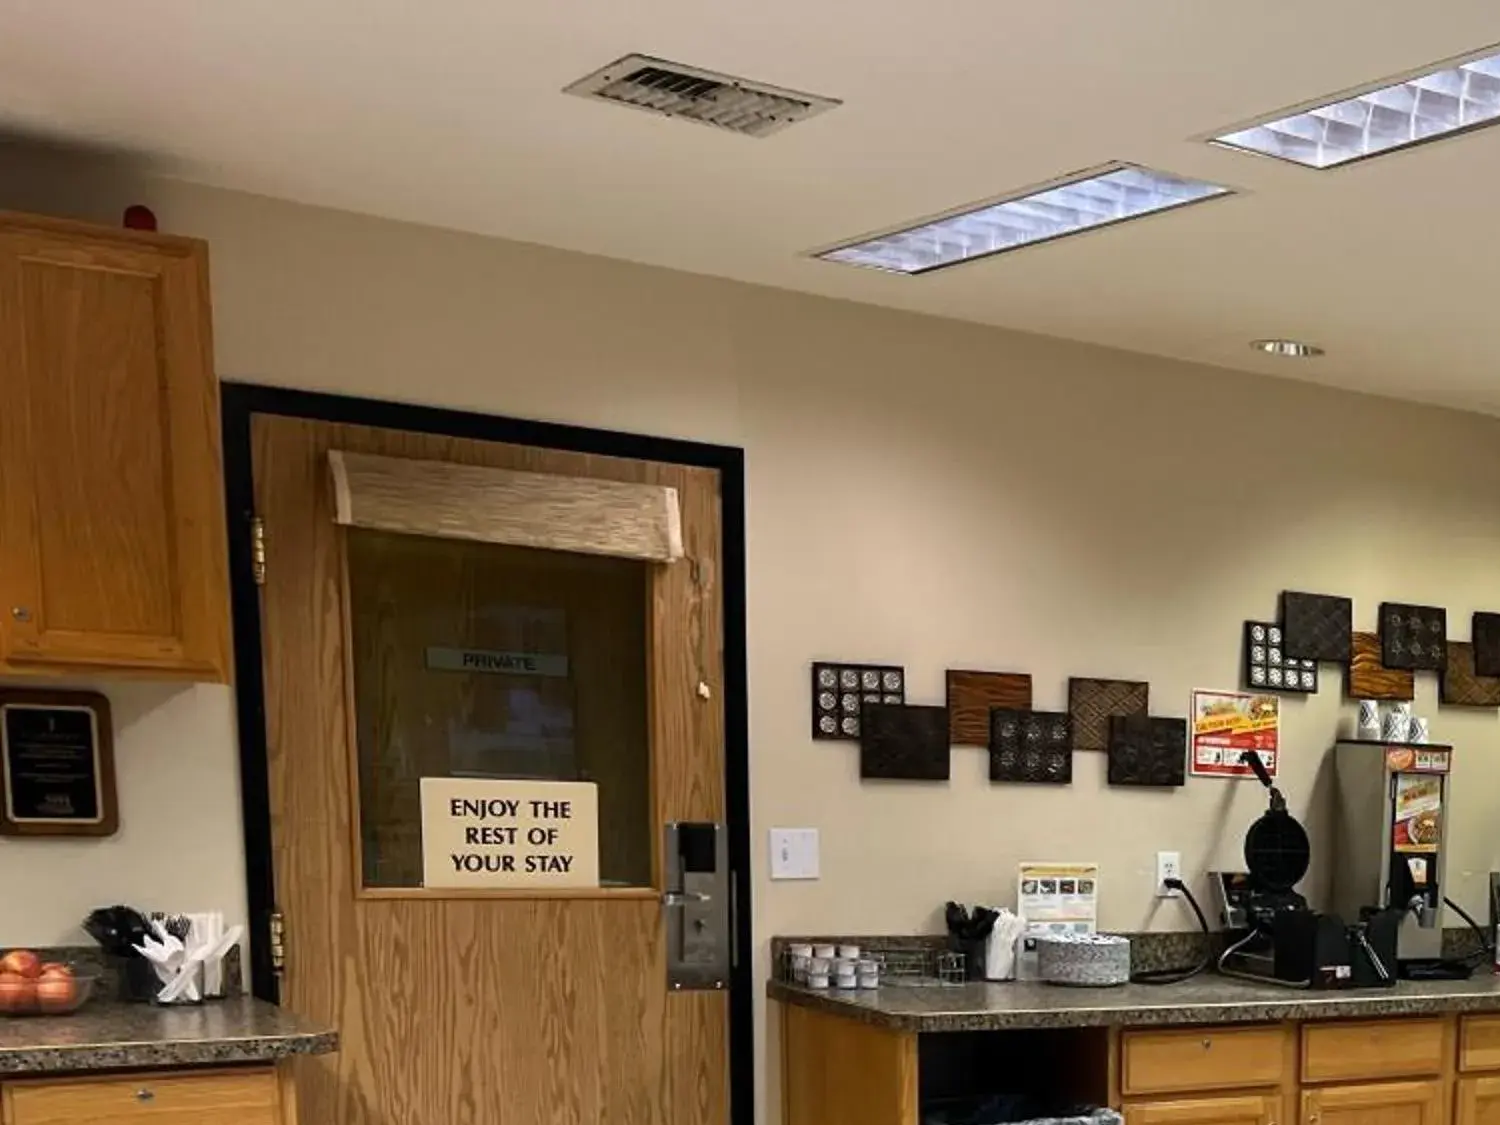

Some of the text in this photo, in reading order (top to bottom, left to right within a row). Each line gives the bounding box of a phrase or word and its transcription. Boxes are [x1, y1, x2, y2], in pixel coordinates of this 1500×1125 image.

[463, 653, 537, 671] PRIVATE
[451, 799, 571, 820] ENJOY THE
[465, 827, 558, 845] REST OF
[451, 854, 573, 873] YOUR STAY
